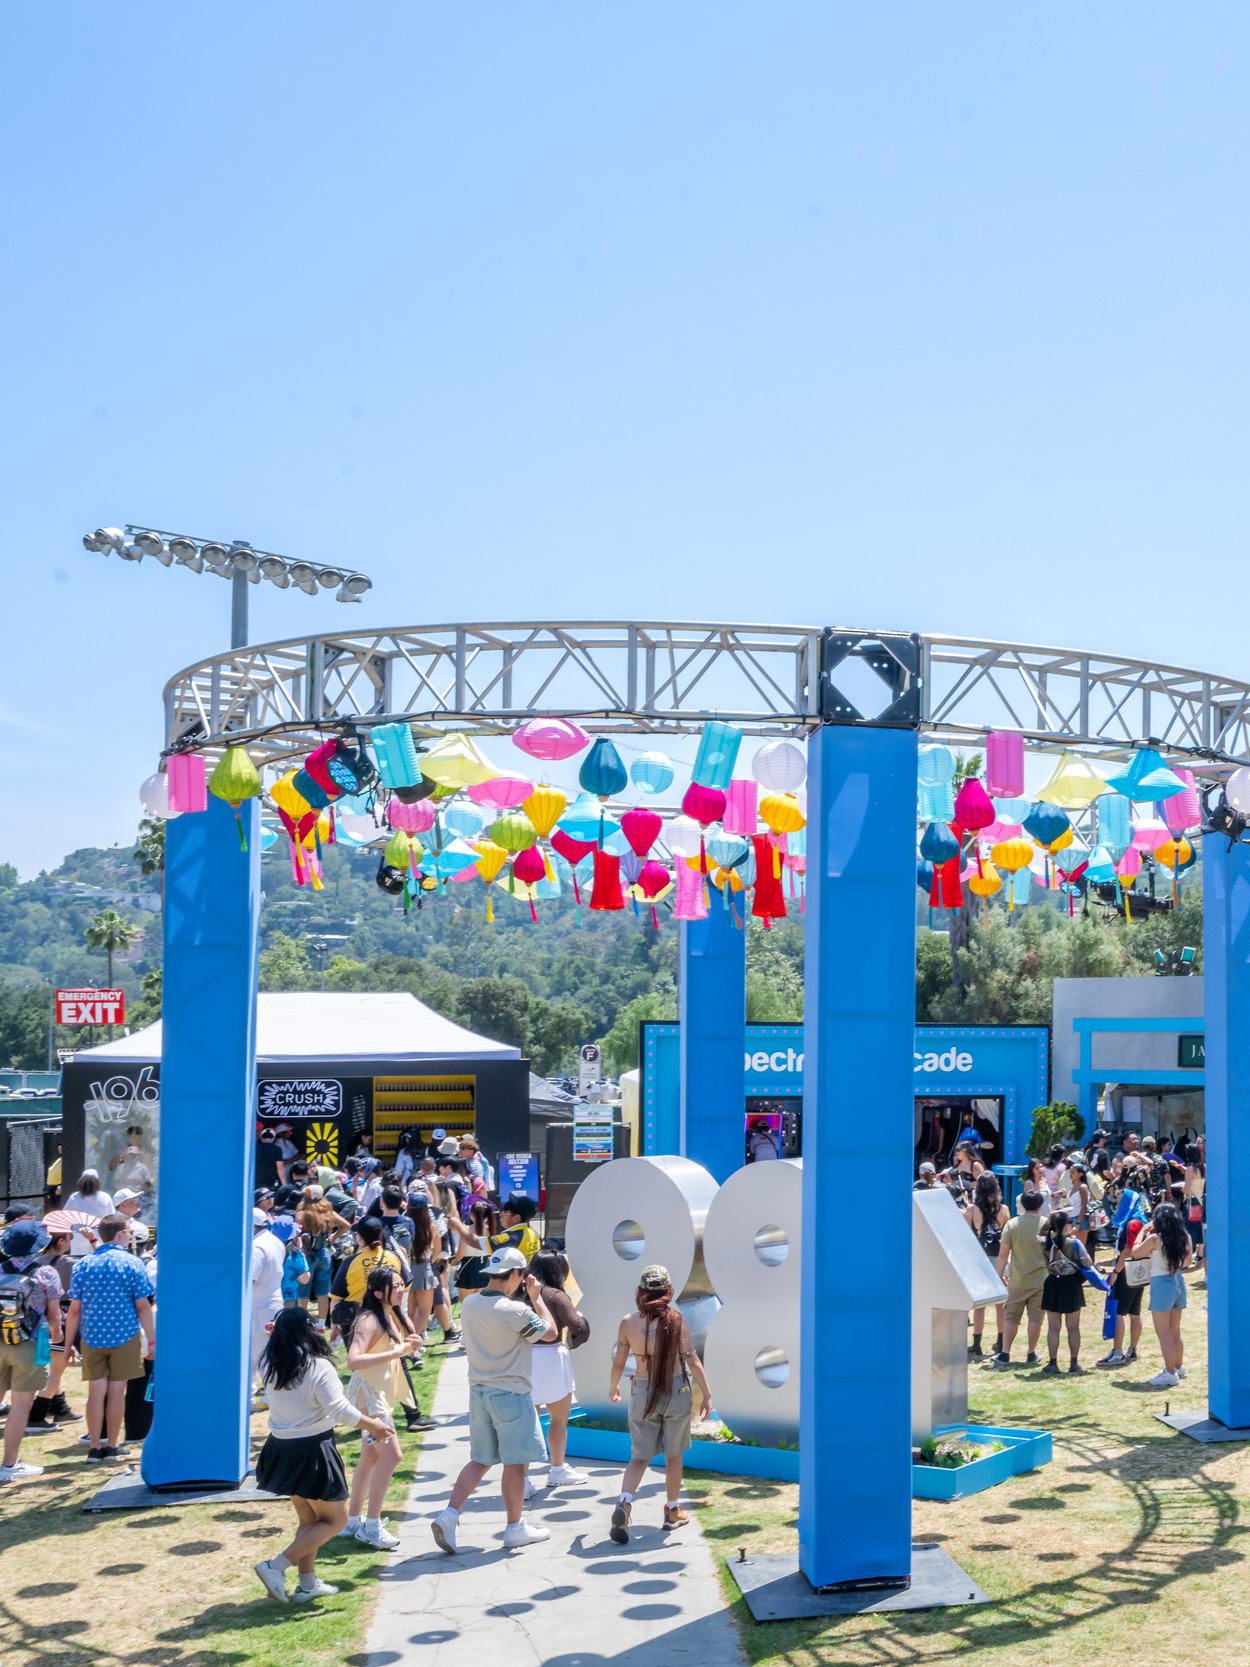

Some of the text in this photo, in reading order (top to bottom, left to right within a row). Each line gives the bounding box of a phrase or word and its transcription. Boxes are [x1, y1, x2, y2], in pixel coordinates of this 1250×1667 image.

[57, 991, 122, 1001] EMERGENCY
[61, 1002, 120, 1024] EXIT
[586, 1052, 595, 1061] F
[744, 1047, 805, 1072] ectr
[275, 1093, 324, 1104] CRUSH
[362, 1255, 388, 1267] CSC
